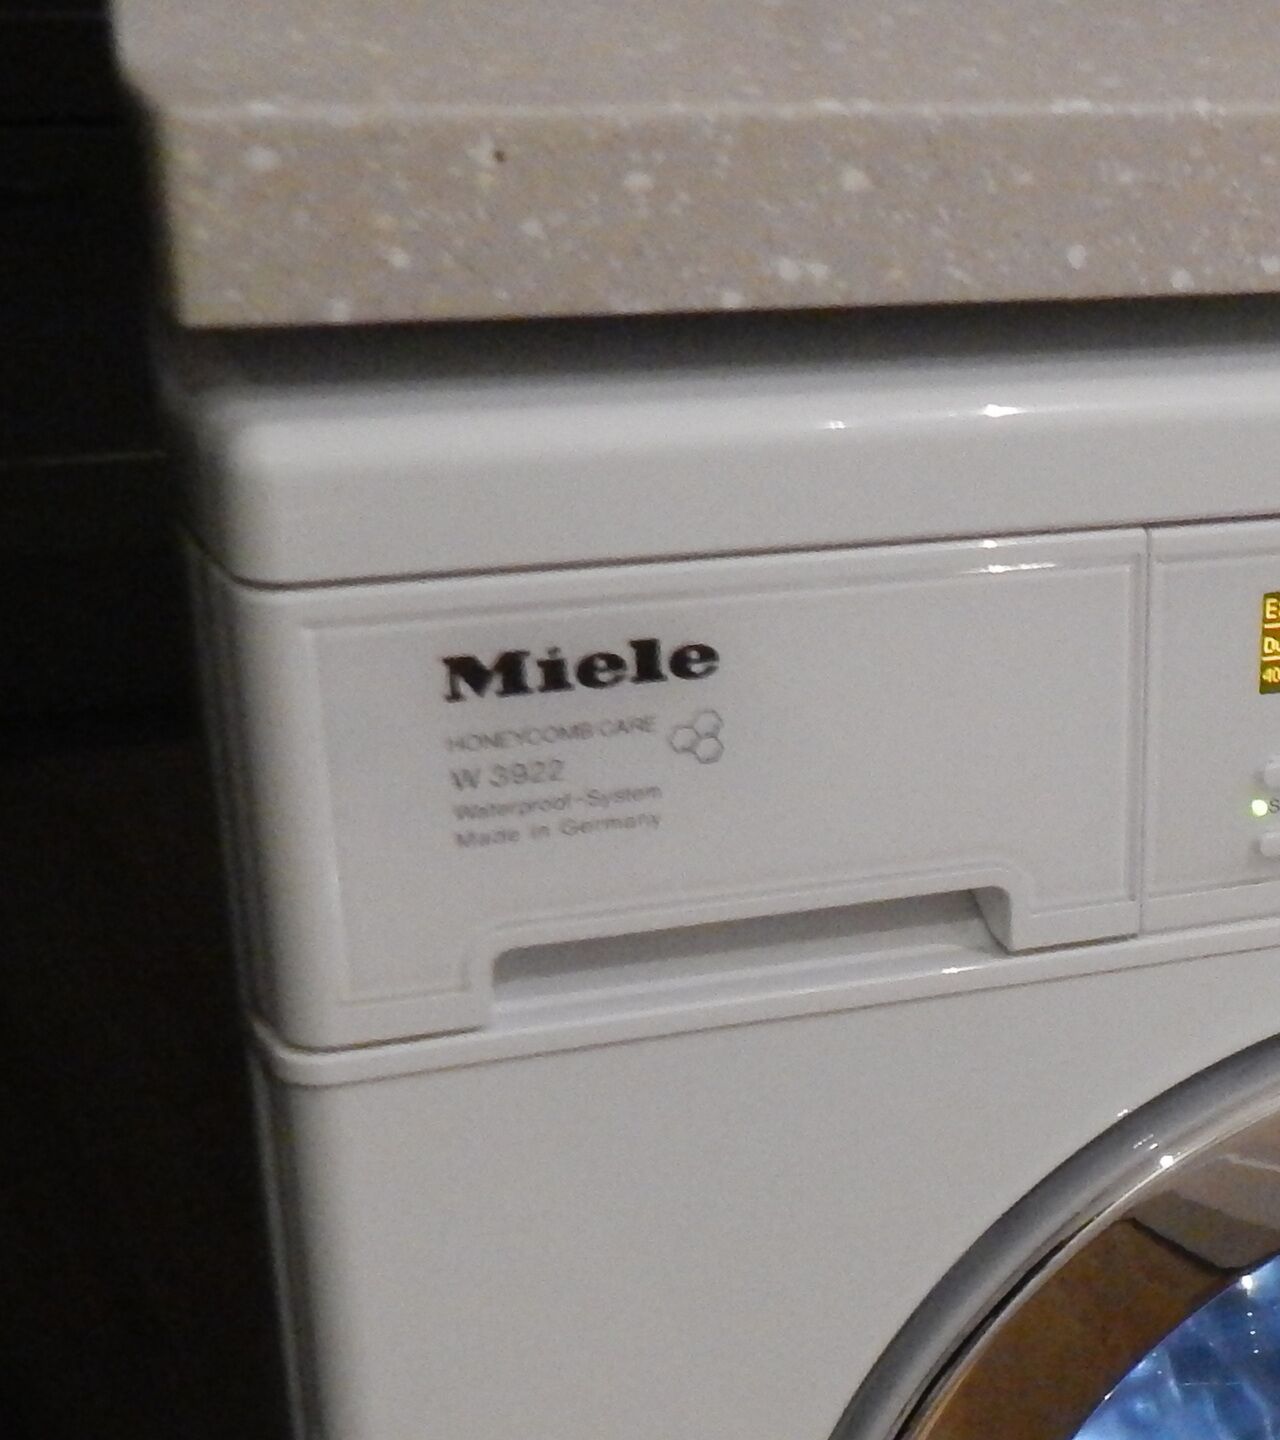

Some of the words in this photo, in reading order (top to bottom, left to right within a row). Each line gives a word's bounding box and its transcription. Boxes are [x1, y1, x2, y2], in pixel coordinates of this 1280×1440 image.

[441, 637, 720, 703] Miele
[599, 714, 656, 737] CARE
[451, 768, 481, 791] W
[489, 758, 565, 788] 3922
[559, 812, 661, 836] Germany
